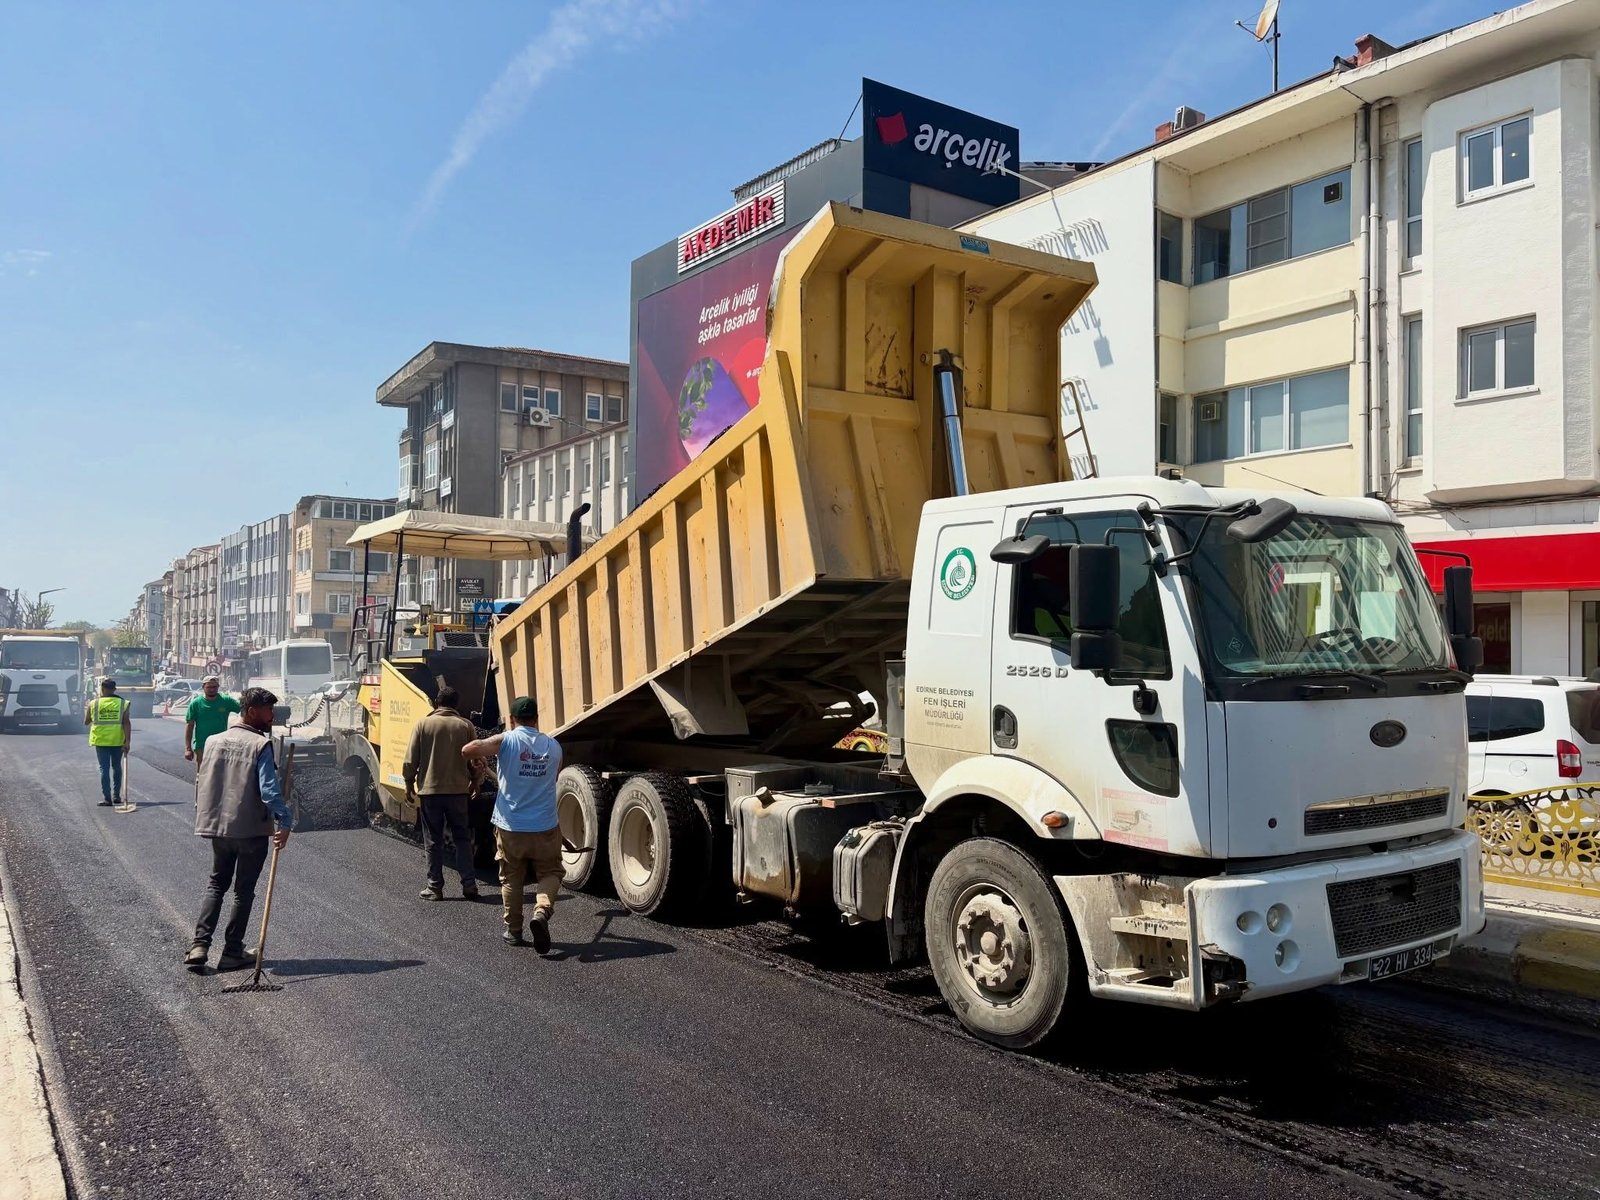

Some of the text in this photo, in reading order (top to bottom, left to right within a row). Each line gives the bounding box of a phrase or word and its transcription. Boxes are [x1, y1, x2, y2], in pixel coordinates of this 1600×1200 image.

[914, 123, 1011, 176] arçelik
[683, 195, 775, 263] AKDEMİR
[699, 283, 759, 324] Arçelik iyiliği
[698, 306, 760, 345] aşkla tasarlar
[1006, 665, 1068, 678] 2526 D
[923, 697, 966, 709] FEN İŞLERİ
[1377, 944, 1432, 977] 22 HV 334
